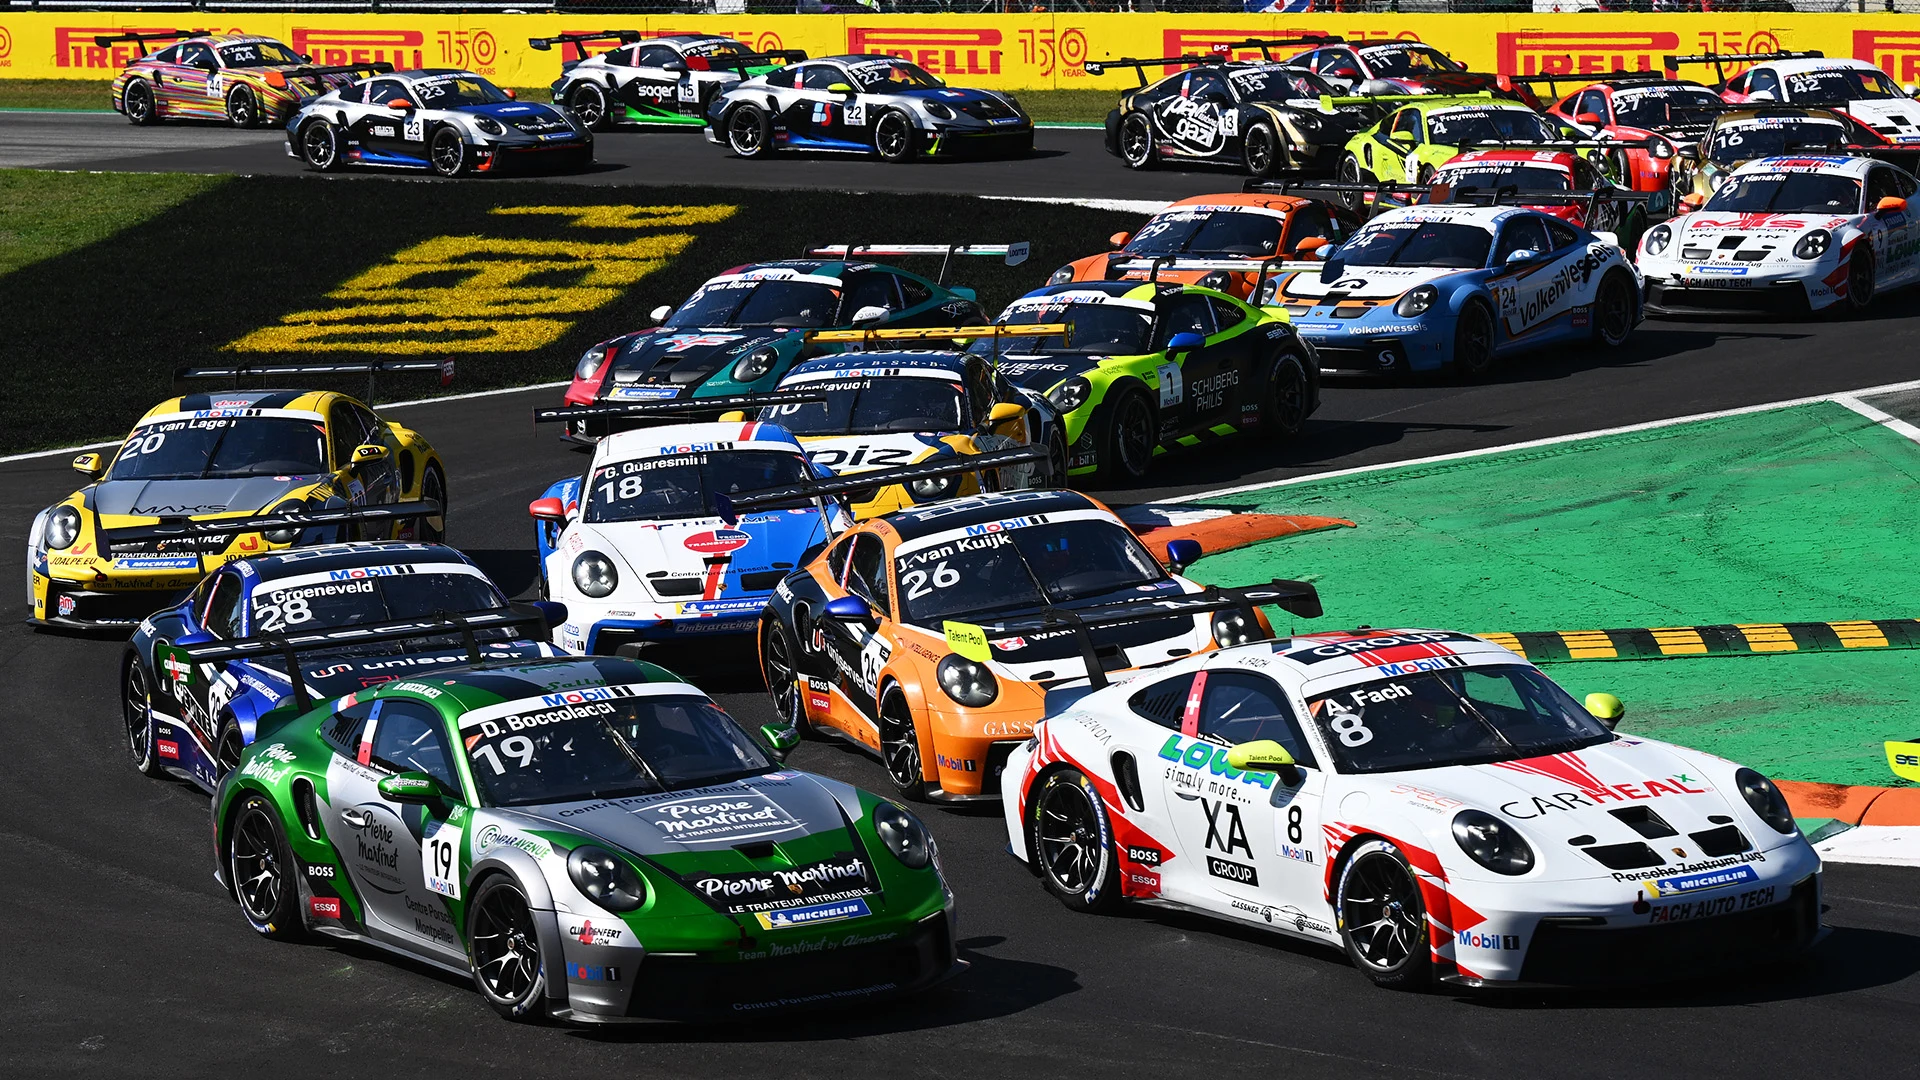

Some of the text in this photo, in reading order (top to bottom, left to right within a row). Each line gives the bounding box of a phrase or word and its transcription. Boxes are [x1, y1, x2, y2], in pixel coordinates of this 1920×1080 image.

[235, 52, 257, 62] 44
[1018, 29, 1088, 77] 150
[1369, 57, 1393, 69] 11
[475, 68, 497, 77] YEARS
[858, 71, 885, 85] 22
[1062, 69, 1087, 78] YEARS
[209, 80, 222, 92] 44
[420, 86, 446, 100] 23
[638, 84, 676, 104] sager
[681, 84, 694, 97] 15
[1240, 79, 1267, 93] 13
[1642, 90, 1669, 100] Kuijk
[1793, 79, 1821, 93] 42
[847, 107, 861, 119] 22
[1613, 100, 1639, 115] 27
[407, 122, 420, 135] 23
[1221, 115, 1234, 129] 13
[1432, 122, 1448, 136] 4
[1717, 133, 1744, 149] 16
[1743, 172, 1787, 185] Hanafin
[1721, 183, 1739, 199] 9
[1195, 204, 1230, 213] Mobil
[1402, 215, 1440, 223] Mobil
[1134, 221, 1170, 241] 29
[1342, 232, 1378, 251] 24
[1678, 258, 1763, 269] Porsche Zentrum Zug
[742, 273, 780, 281] Mobil
[1681, 278, 1753, 288] FACH AUTO TECH
[707, 280, 761, 294] van Burer
[682, 289, 706, 311] 2
[1050, 296, 1091, 304] Mobil
[1502, 286, 1517, 309] 24
[1572, 306, 1588, 314] BOSS
[1348, 322, 1428, 336] VolkerWessels
[834, 369, 881, 378] Mobil
[1166, 371, 1174, 395] 1
[1191, 368, 1240, 398] SCHUBERG
[1196, 389, 1224, 413] PHILIS
[1241, 403, 1259, 412] BOSS
[193, 408, 244, 418] Mobil
[159, 421, 186, 434] van
[118, 434, 167, 462] 20
[660, 443, 715, 455] Mobil
[603, 455, 709, 481] G. Quaresmini
[597, 475, 644, 505] 18
[130, 503, 228, 515] MAX'S
[965, 515, 1029, 539] Mobil
[118, 551, 157, 560] TRAITEUR
[898, 532, 1013, 575] J. van Kuijk
[49, 556, 98, 570] JOALPE.EU
[132, 560, 190, 569] MICHELIN
[670, 565, 770, 579] Centro Brescia
[329, 565, 393, 583] Mobil
[901, 560, 962, 603] 26
[252, 580, 374, 613] L. Groeneveld
[702, 598, 768, 611] MICHELIN
[255, 597, 314, 635] 28
[947, 629, 985, 647] Talent Pool
[825, 641, 866, 691] uniserver
[1377, 656, 1447, 679] Mobil
[809, 678, 829, 692] BOSS
[541, 686, 612, 709] Mobil
[812, 697, 830, 710] ESSO
[1323, 682, 1414, 718] A. Fach
[480, 702, 617, 742] D. Boccolacci
[1330, 711, 1374, 749] 8
[157, 727, 172, 737] BOSS
[160, 744, 178, 757] ESSO
[471, 735, 537, 779] 19
[1248, 754, 1268, 762] Talent
[936, 753, 964, 773] Mobil
[1164, 767, 1206, 794] simply
[557, 777, 795, 819] Centre Porsche Montpellier
[661, 800, 754, 820] Pierre
[362, 810, 394, 848] Pierre
[654, 809, 777, 836] Martinet
[672, 817, 793, 842] LE TRAITEUR INTRAITABLE
[1200, 797, 1256, 860] XA
[1288, 805, 1304, 845] 8
[355, 835, 399, 875] Martinet
[430, 839, 452, 883] 19
[1130, 848, 1160, 864] BOSS
[1282, 844, 1305, 861] Mobil
[308, 864, 334, 880] BOSS
[1211, 860, 1254, 884] GROUP
[1611, 851, 1767, 886] Porsche Zentrum Zug
[429, 877, 448, 896] Mobil
[696, 857, 865, 899] Pierre Martinet
[1131, 873, 1158, 888] ESSO
[1680, 870, 1749, 891] MICHELIN
[314, 902, 337, 915] ESSO
[404, 896, 428, 919] Centre
[728, 885, 875, 915] LE TRAITEUR INTRAITABLE
[1650, 885, 1777, 924] FACH AUTO TECH
[792, 903, 860, 923] MICHELIN
[414, 915, 455, 948] Montpellier
[568, 924, 586, 938] CLIM
[1458, 930, 1502, 950] Mobil
[738, 931, 900, 963] Team Martinet by Almeras
[567, 960, 604, 982] Mobil
[732, 981, 898, 1013] Centre Porsche Montpellier
